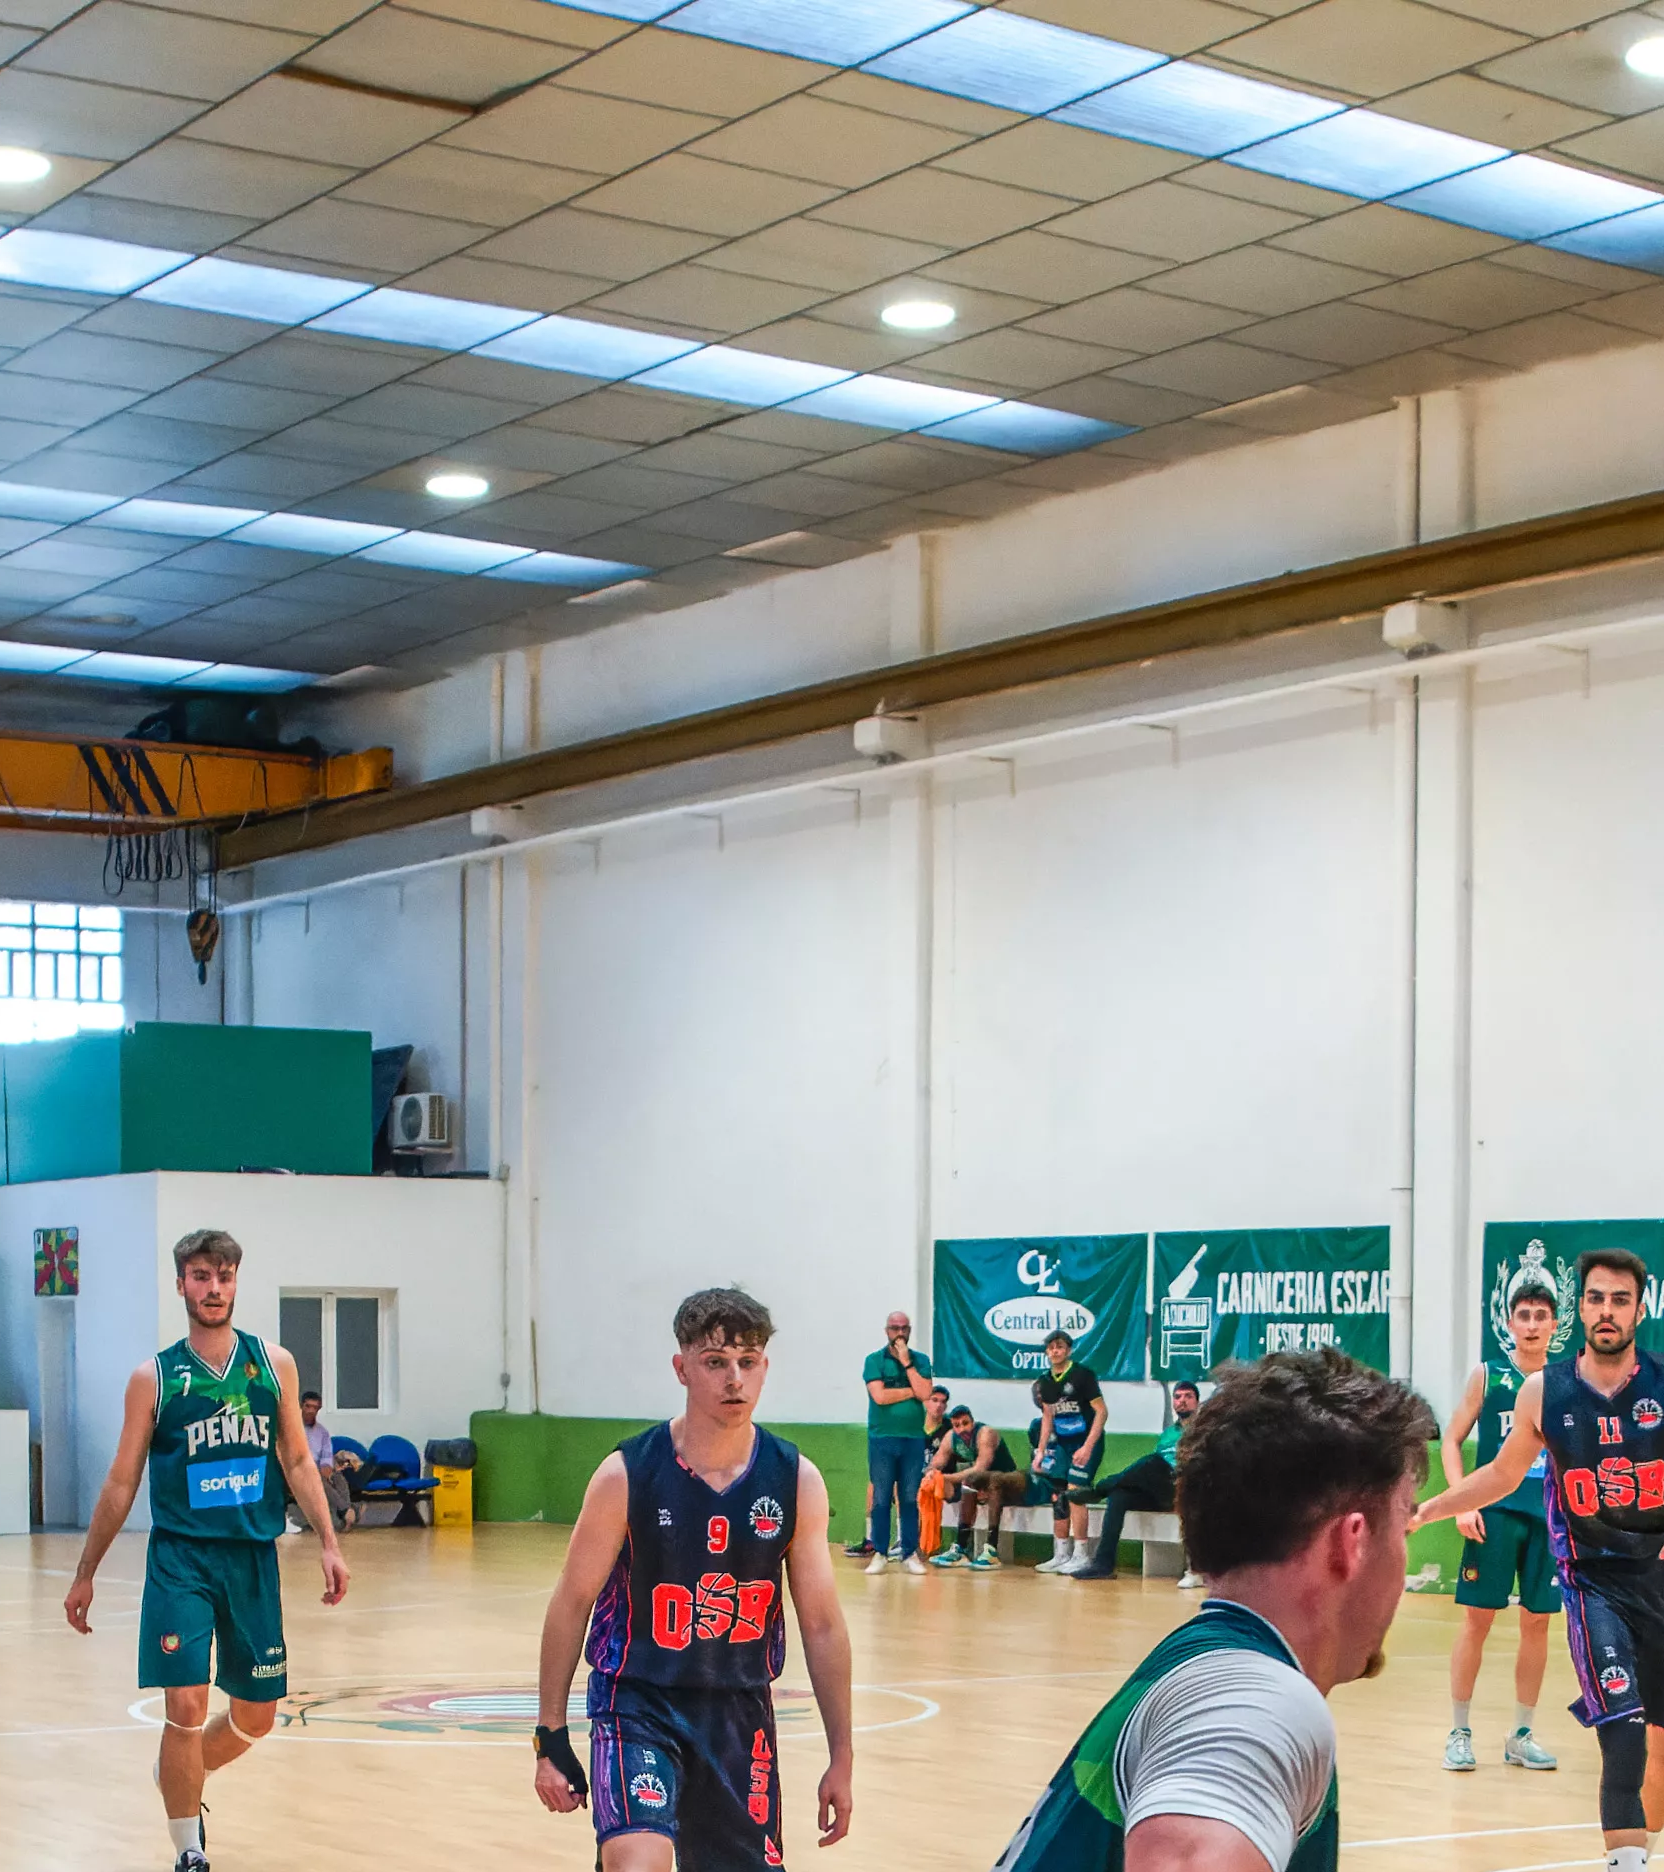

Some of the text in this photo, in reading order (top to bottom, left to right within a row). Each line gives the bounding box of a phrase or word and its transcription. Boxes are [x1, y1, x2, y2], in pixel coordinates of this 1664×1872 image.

[1216, 1271, 1328, 1315] CARNICERIA
[990, 1309, 1088, 1331] Central Lab
[1266, 1322, 1306, 1355] DESDE
[178, 1371, 192, 1397] 7
[1500, 1372, 1514, 1391] 4
[1597, 1416, 1623, 1444] 11
[707, 1515, 730, 1554] 9
[652, 1572, 775, 1651] OSB
